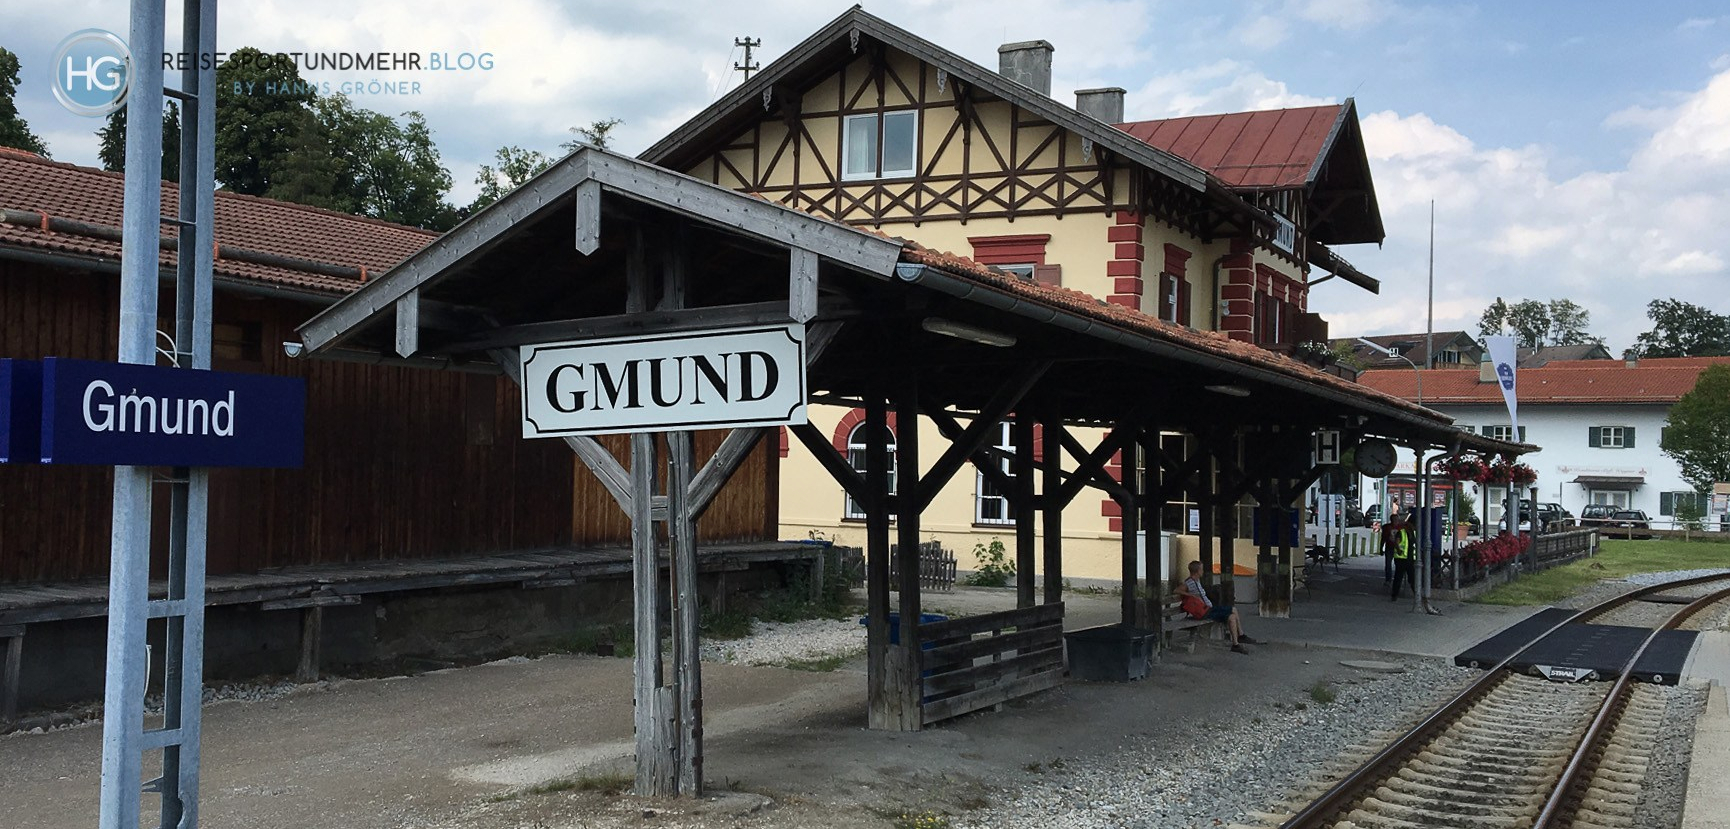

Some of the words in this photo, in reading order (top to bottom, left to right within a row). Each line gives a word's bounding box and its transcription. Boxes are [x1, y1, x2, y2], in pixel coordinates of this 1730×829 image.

[82, 379, 236, 437] Gmund
[545, 350, 780, 414] GMUND
[1318, 433, 1337, 462] H
